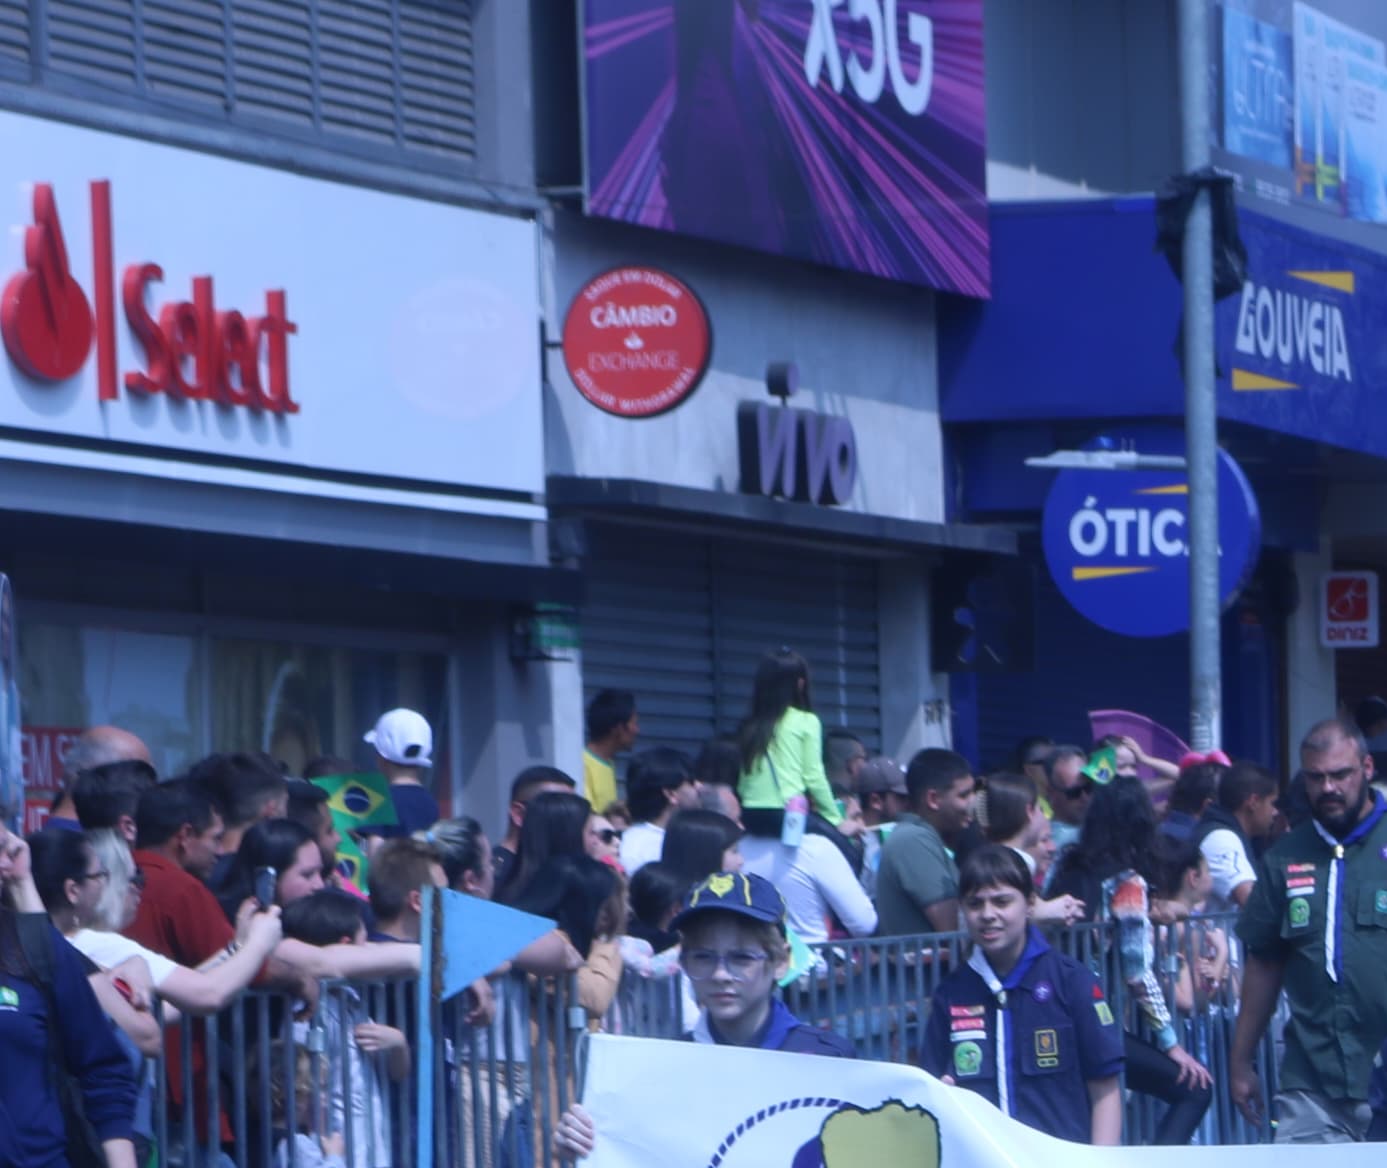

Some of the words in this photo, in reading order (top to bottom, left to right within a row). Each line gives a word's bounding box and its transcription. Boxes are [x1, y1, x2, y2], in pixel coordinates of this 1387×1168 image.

[122, 262, 300, 414] Select
[588, 301, 678, 328] CÂMBIO
[1234, 280, 1352, 383] GOUVEIA
[587, 350, 680, 372] EXCHANGE
[1069, 495, 1223, 557] ÓTIC
